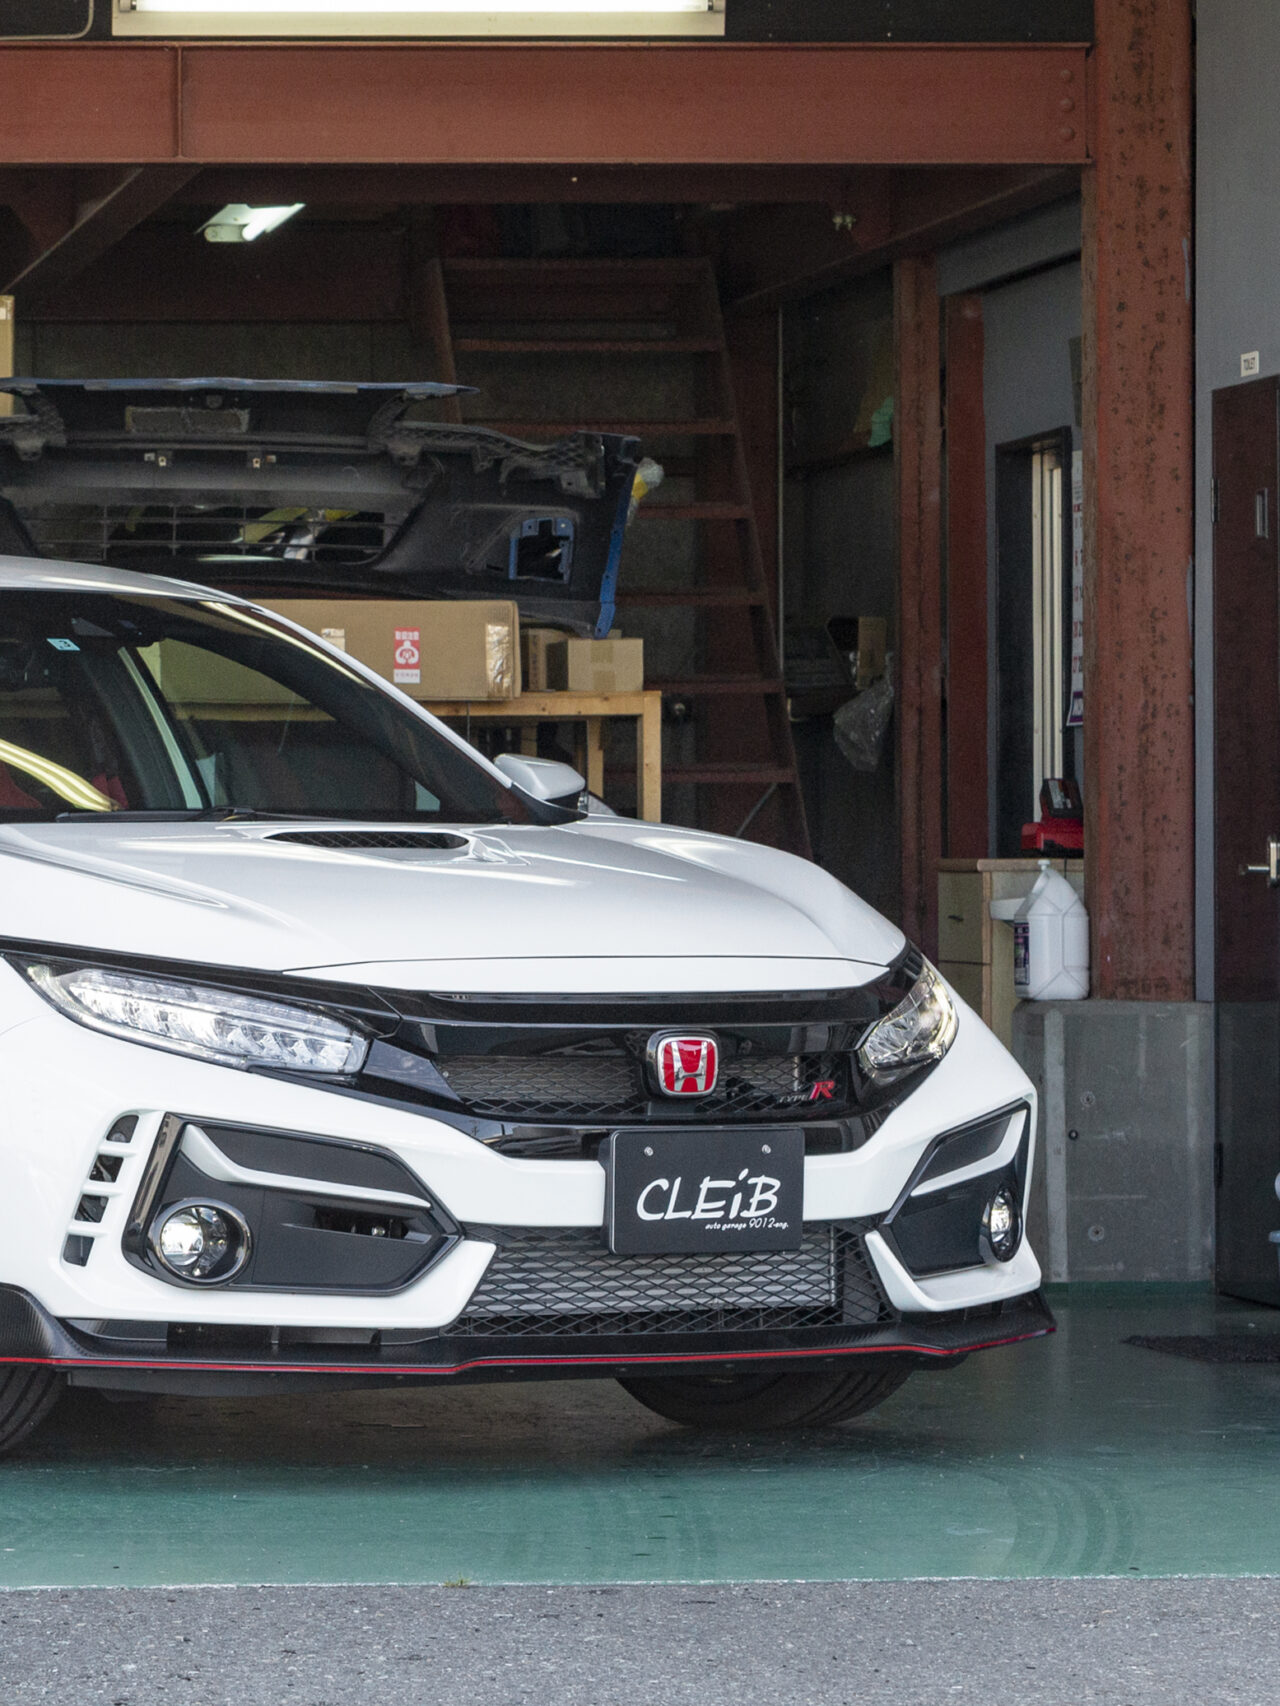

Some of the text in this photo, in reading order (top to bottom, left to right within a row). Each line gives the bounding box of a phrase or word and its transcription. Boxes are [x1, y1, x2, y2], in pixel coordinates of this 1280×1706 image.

[809, 1080, 835, 1100] R
[705, 1222, 721, 1230] auto
[722, 1222, 747, 1231] garage
